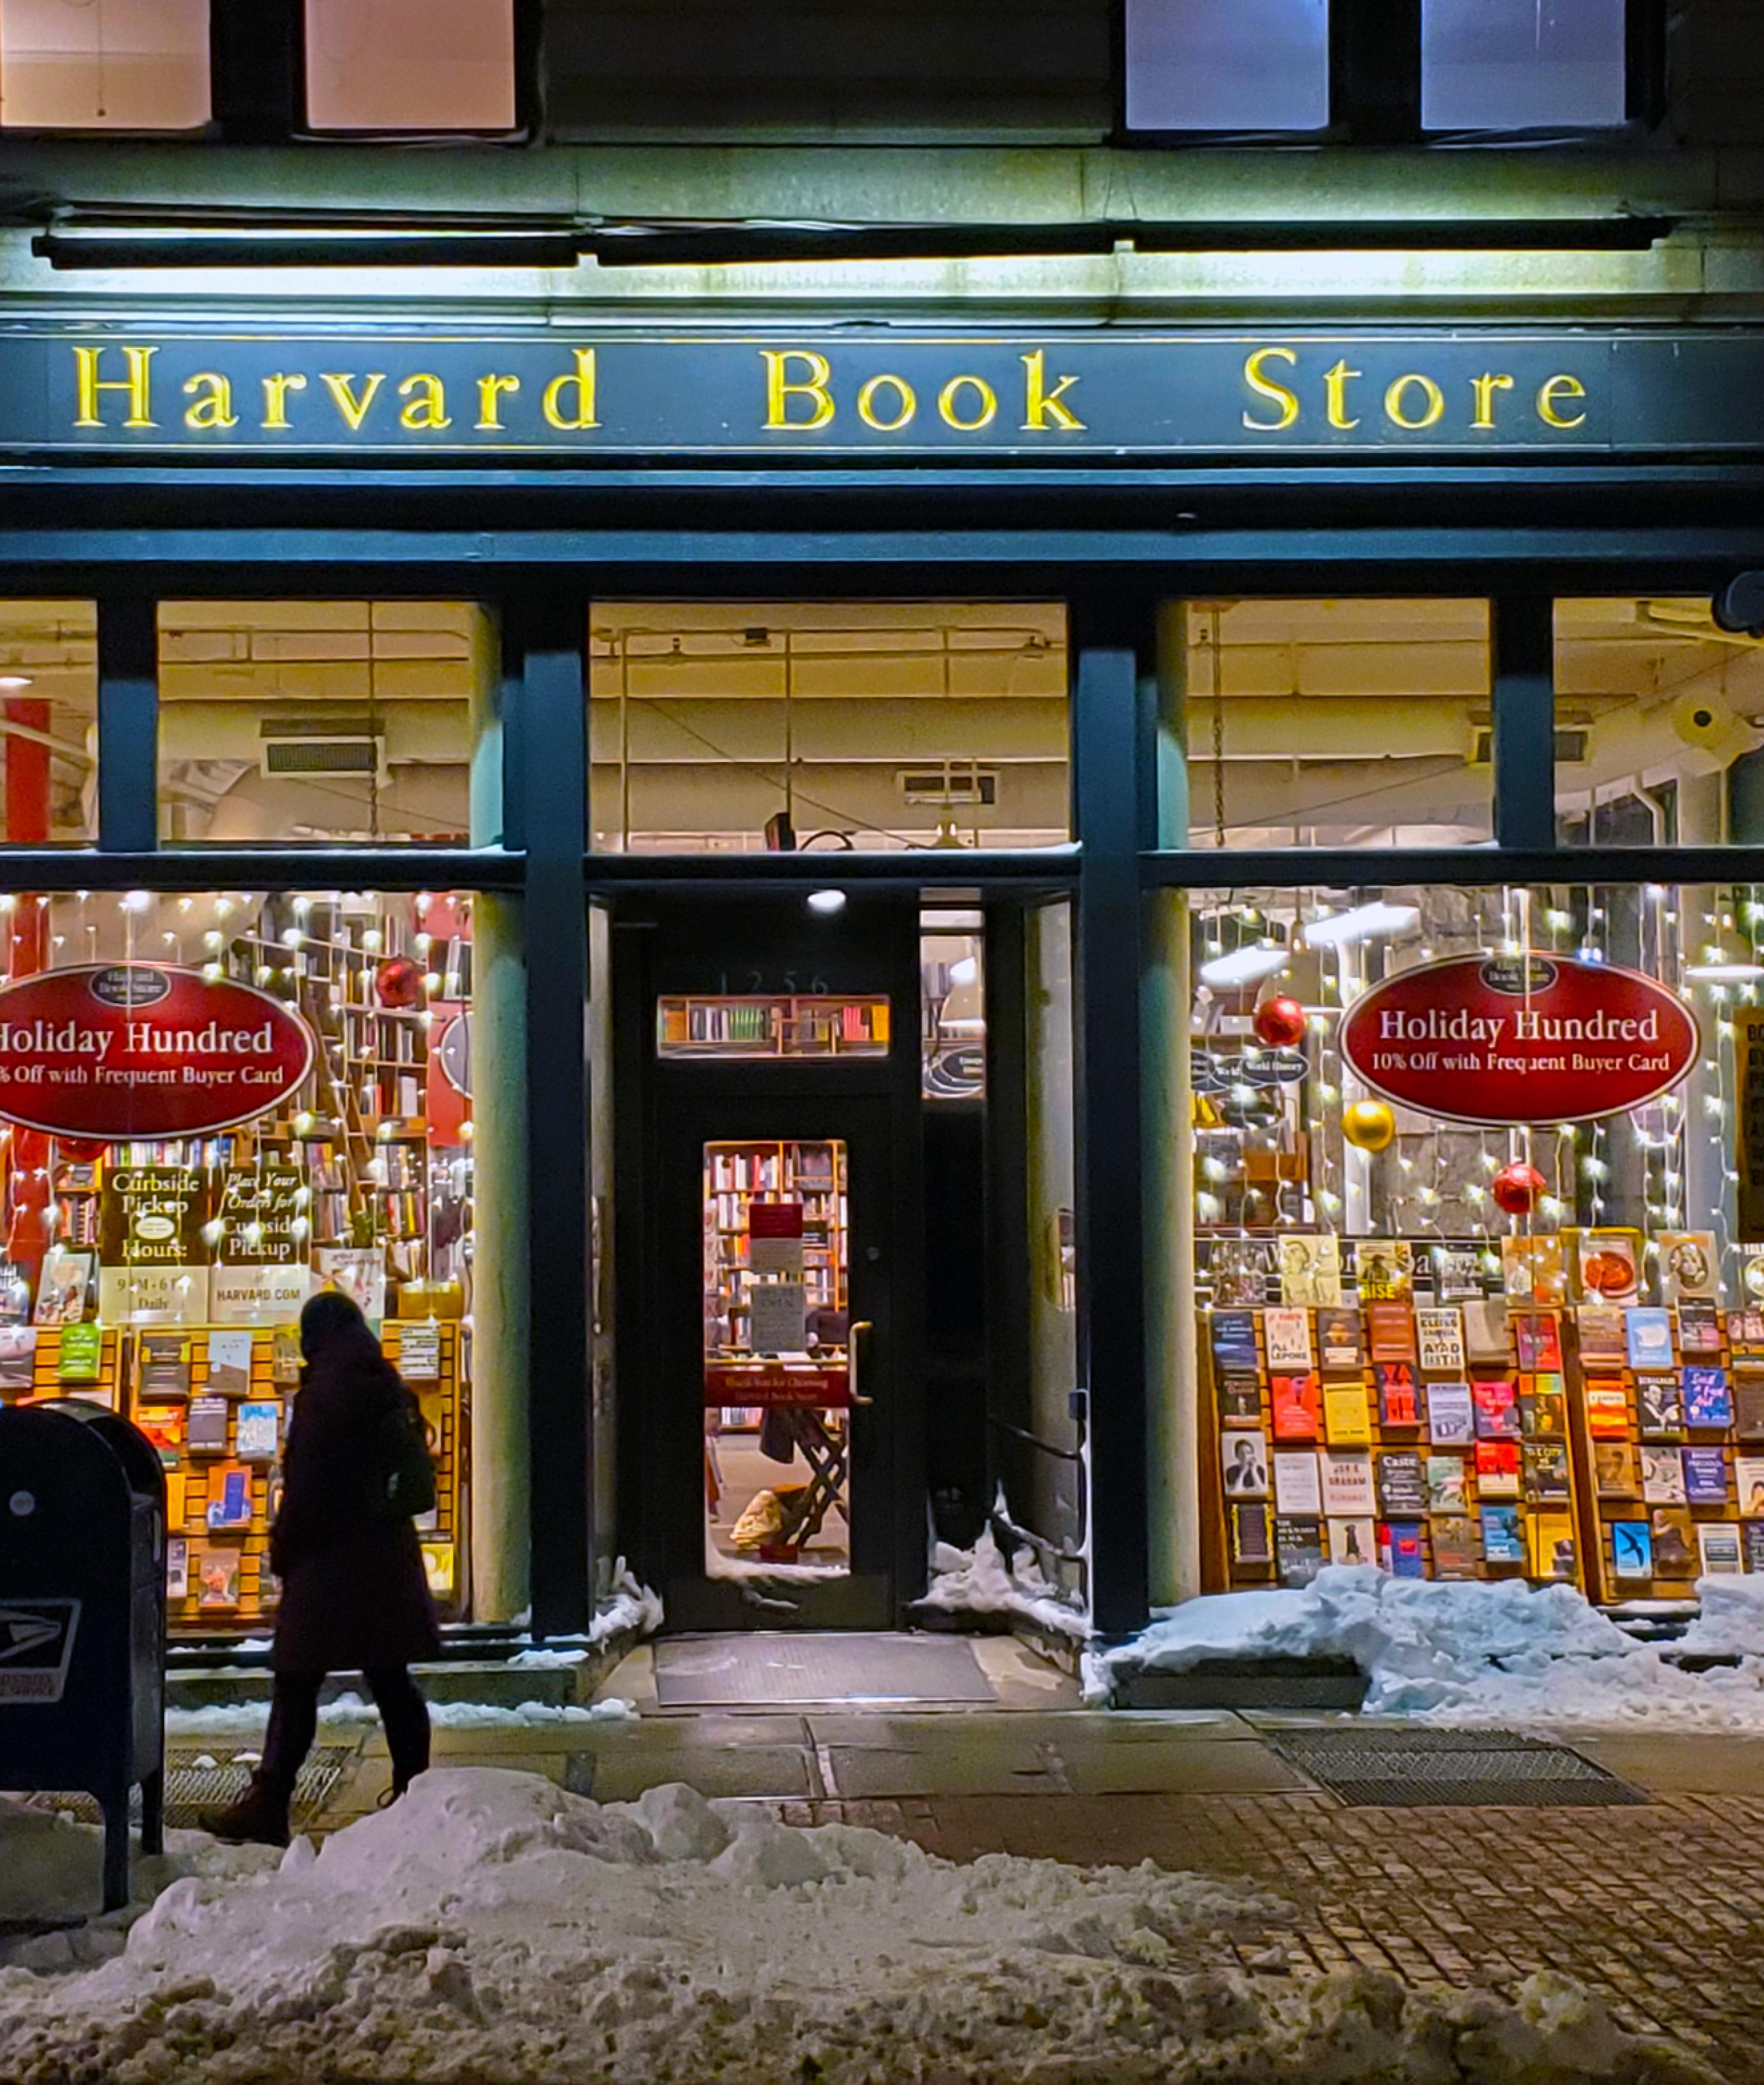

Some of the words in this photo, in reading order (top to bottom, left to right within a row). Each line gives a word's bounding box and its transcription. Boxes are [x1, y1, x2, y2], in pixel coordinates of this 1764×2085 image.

[72, 345, 603, 429] Harvard
[759, 348, 1088, 431] Book
[1242, 346, 1586, 430] Store
[123, 1020, 273, 1053] Hundred
[1380, 1009, 1505, 1048] Holiday
[1515, 1009, 1660, 1041] Hundred
[1372, 1053, 1407, 1070] 10%
[1411, 1051, 1438, 1070] Off
[1443, 1052, 1481, 1070] with
[1487, 1052, 1566, 1075] Frequent
[1572, 1053, 1623, 1075] Buyer
[1628, 1052, 1670, 1071] Card
[14, 1064, 46, 1083] Off
[47, 1064, 88, 1084] with
[95, 1065, 176, 1088] Frequent
[182, 1066, 236, 1088] Buyer
[240, 1065, 283, 1084] Card
[112, 1172, 200, 1192] Curbside
[265, 1172, 297, 1187] Your
[271, 1193, 294, 1213] for
[223, 1214, 301, 1234] Cusid
[229, 1237, 291, 1261] Pickup
[159, 1278, 167, 1291] 6
